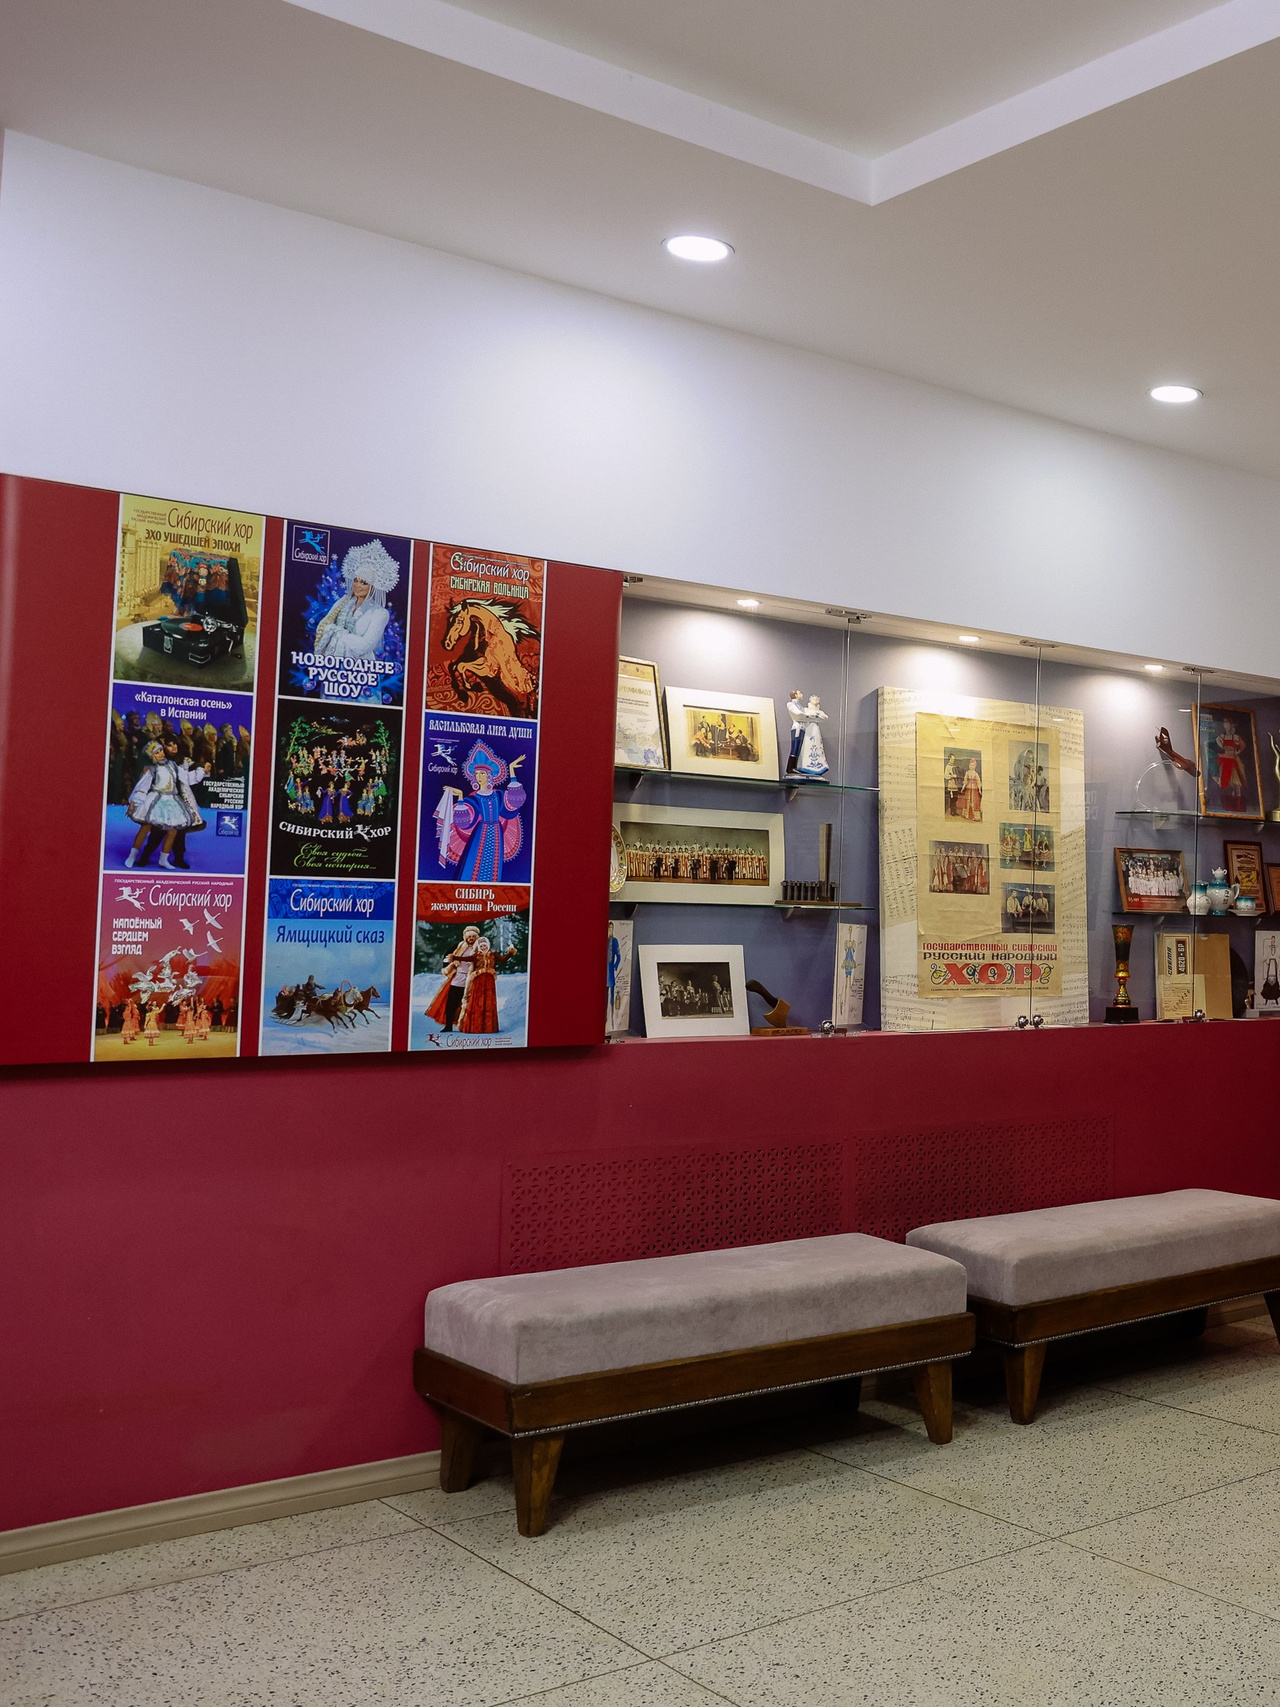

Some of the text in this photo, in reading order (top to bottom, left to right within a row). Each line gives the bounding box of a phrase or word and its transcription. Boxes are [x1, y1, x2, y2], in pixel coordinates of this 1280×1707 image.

[168, 508, 253, 544] Сибирский хор
[145, 529, 241, 553] ЭХО УШЕДШЕЙ ЭПОХИ
[450, 552, 510, 578] Сибирский
[511, 568, 530, 584] хор
[450, 576, 529, 599] СИБИРСКАЯ ВОЛЬНИЦА
[291, 651, 394, 674] НОВОГОДНЕЕ
[308, 667, 377, 686] РУССКОЕ
[323, 681, 361, 698] ШОУ
[134, 691, 232, 709] «Каталонская осень»
[161, 707, 206, 720] в Испании
[429, 719, 533, 740] ВАСИЛЬКОВАЯ ЛИРА ДУШИ
[279, 821, 392, 839] СИБИРСКИЙ ХОР
[149, 884, 233, 912] Сибирский хор
[455, 888, 495, 899] СИБИРЬ
[290, 888, 374, 918] Сибирский хор
[431, 901, 517, 912] жемчужина России
[113, 917, 163, 930] НАПОЁННЫЙ
[112, 931, 149, 942] СЕРДЦЕМ
[276, 925, 385, 947] Ямщицкий сказ
[112, 944, 142, 955] ВЗГЛЯД
[923, 942, 1008, 951] ГОСУДАРСТВЕННЫЙ
[924, 951, 1058, 961] РУССКИЙ НАРОДНЫЙ
[943, 963, 1043, 985] ХОР
